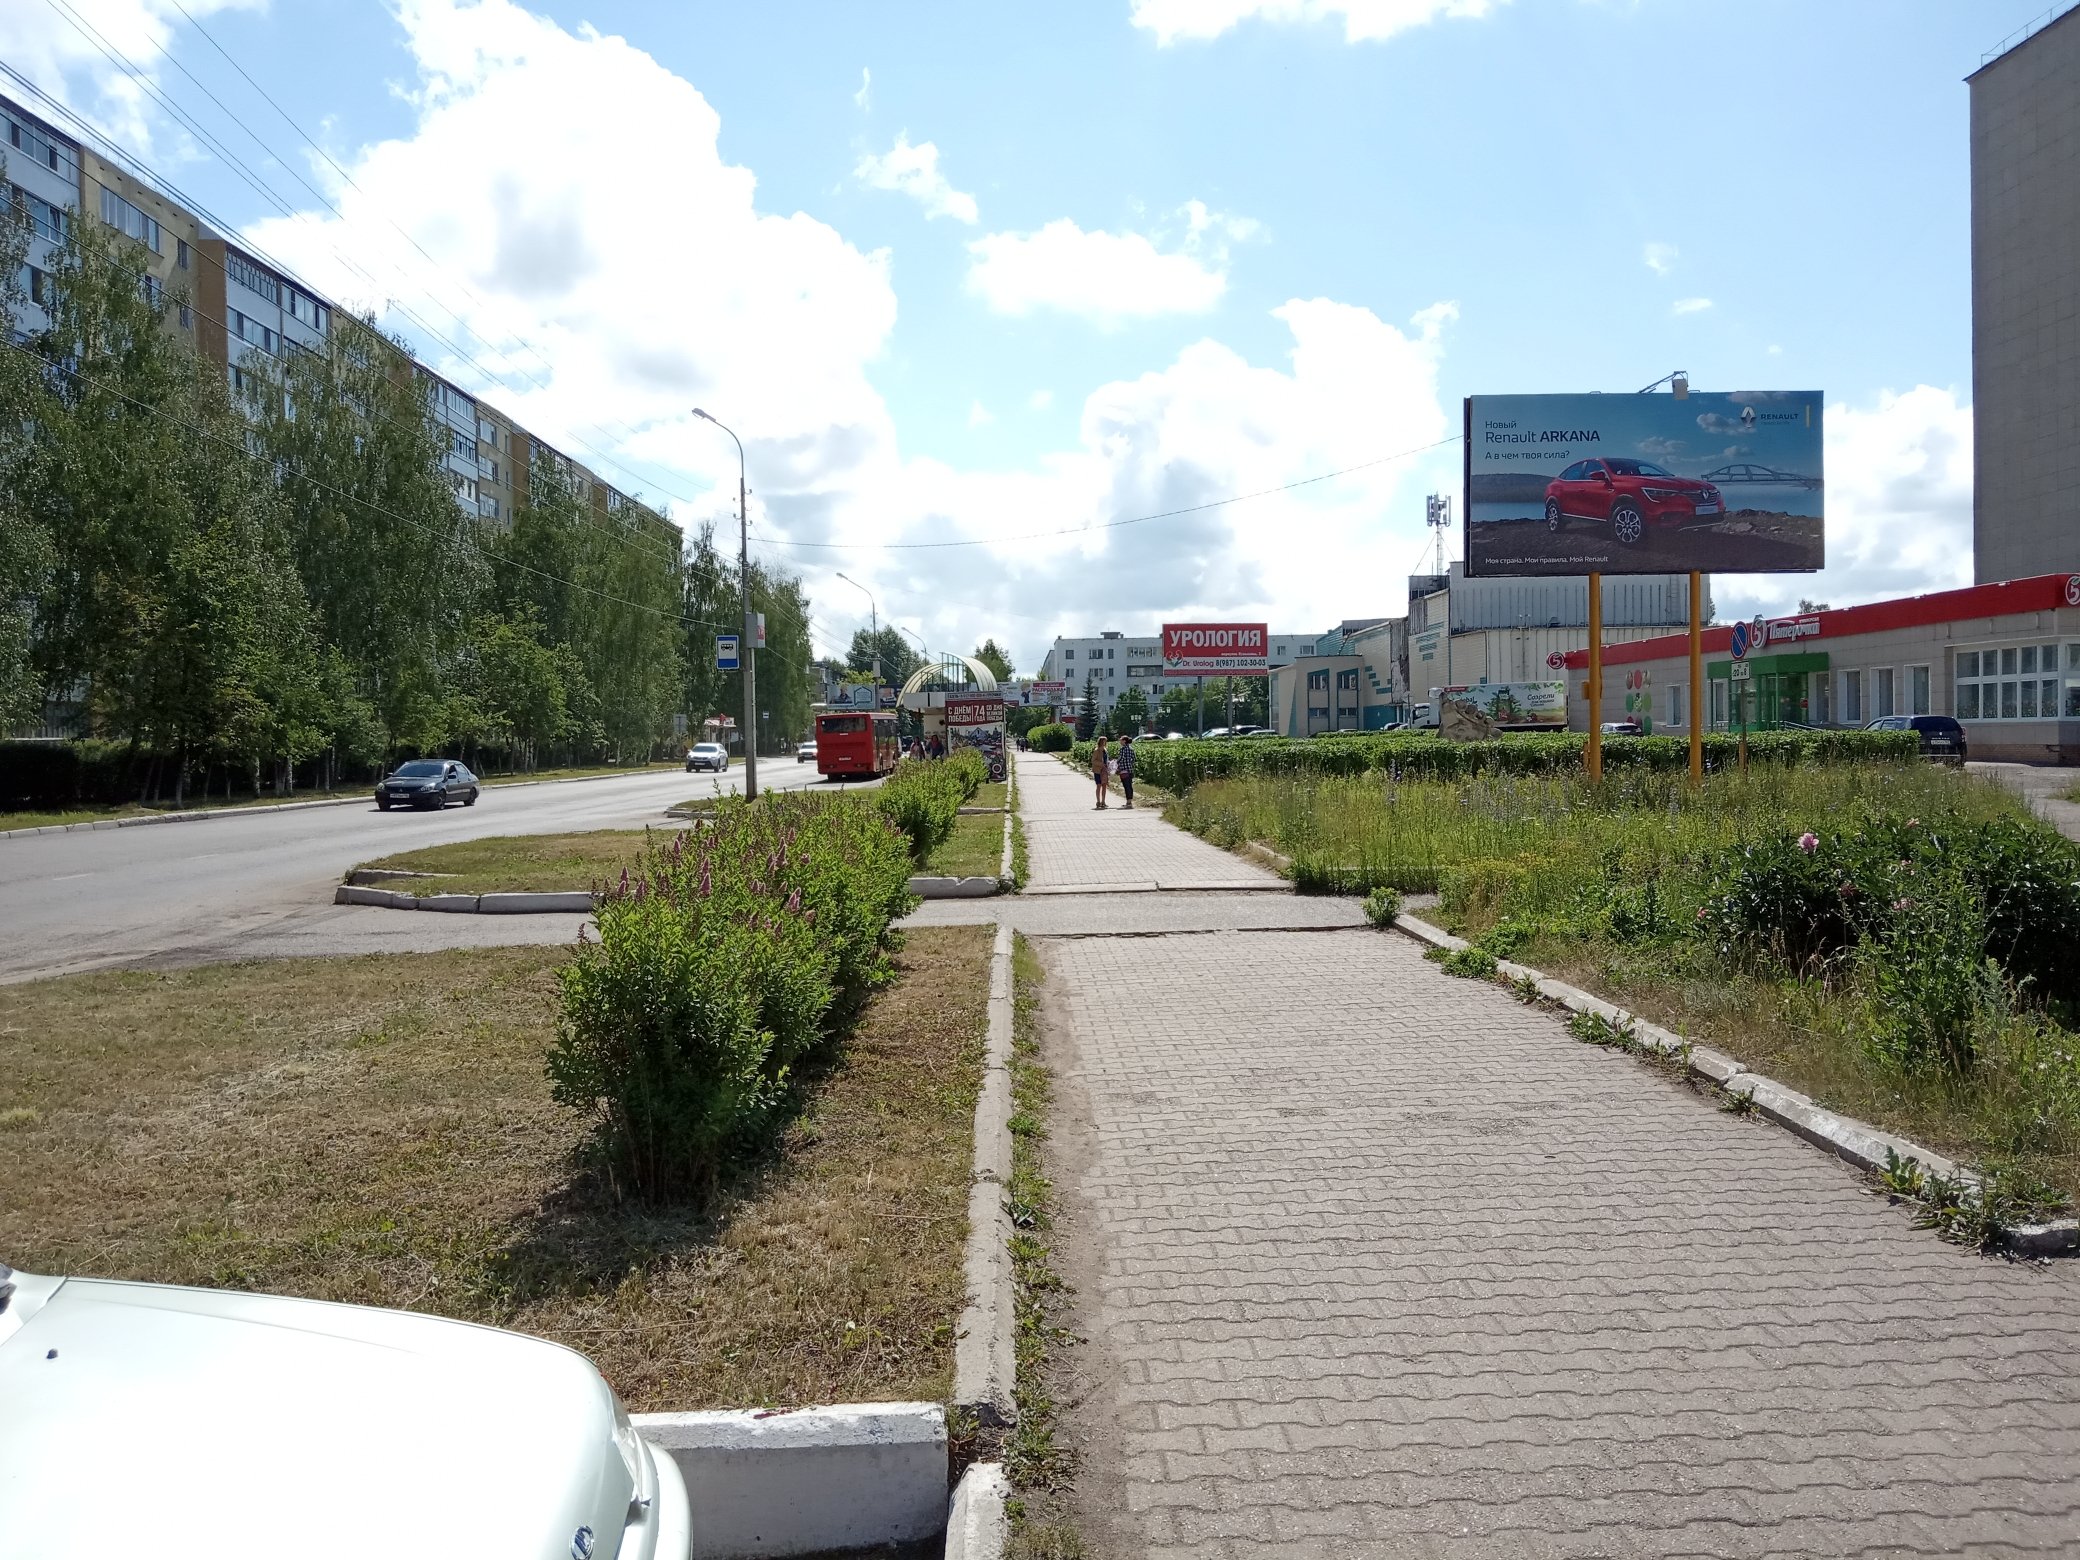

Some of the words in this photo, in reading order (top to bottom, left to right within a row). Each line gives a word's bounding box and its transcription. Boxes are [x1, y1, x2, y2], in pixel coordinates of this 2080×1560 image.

[1485, 421, 1517, 429] Новый
[1485, 431, 1537, 443] Renault
[1540, 430, 1601, 442] ARKANA
[1485, 452, 1492, 460] А
[1544, 451, 1570, 459] сила?
[1169, 629, 1261, 647] УРОЛОГИЯ
[1193, 659, 1215, 668] Urolog
[1215, 659, 1236, 668] 8(987)
[1237, 659, 1266, 667] 102-30-03
[1527, 693, 1555, 702] Созрели
[948, 706, 953, 715] С
[954, 705, 972, 715] ДНЁМ
[974, 705, 985, 717] 74
[948, 714, 972, 722] ПОБЕДЫ
